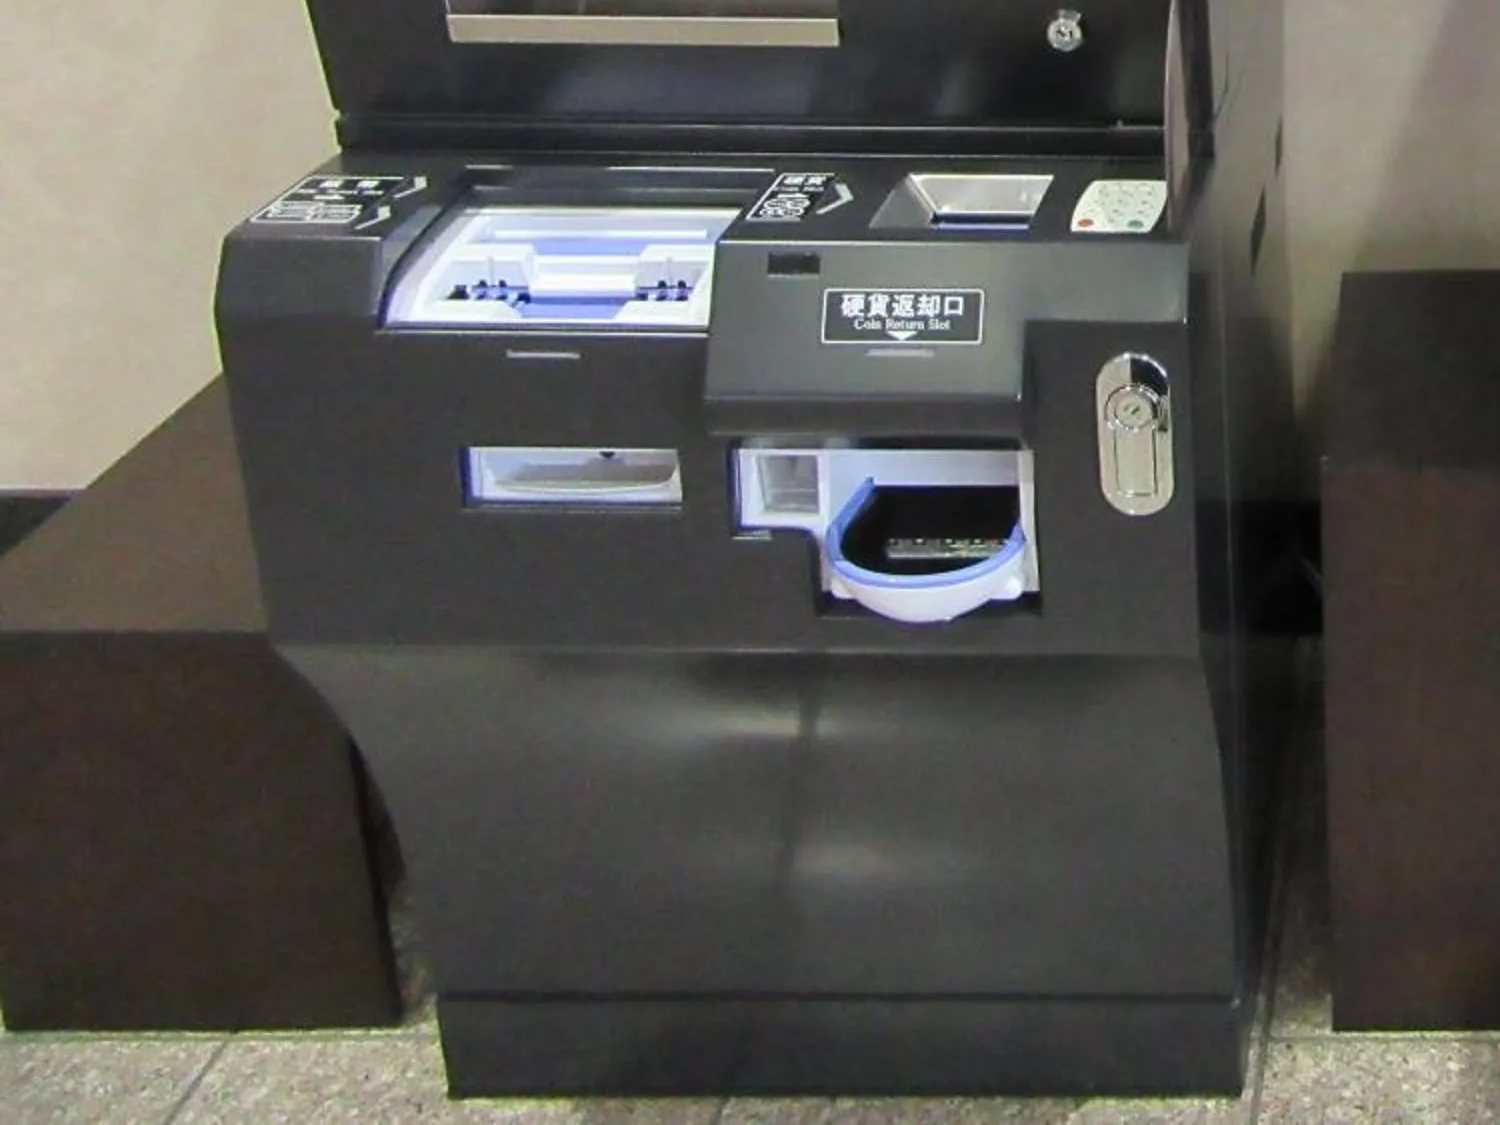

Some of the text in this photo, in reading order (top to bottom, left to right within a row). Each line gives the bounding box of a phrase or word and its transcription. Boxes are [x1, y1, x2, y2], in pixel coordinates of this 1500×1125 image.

[841, 293, 965, 318] 硬貨返却口
[853, 318, 951, 330] Coin Return Slot
